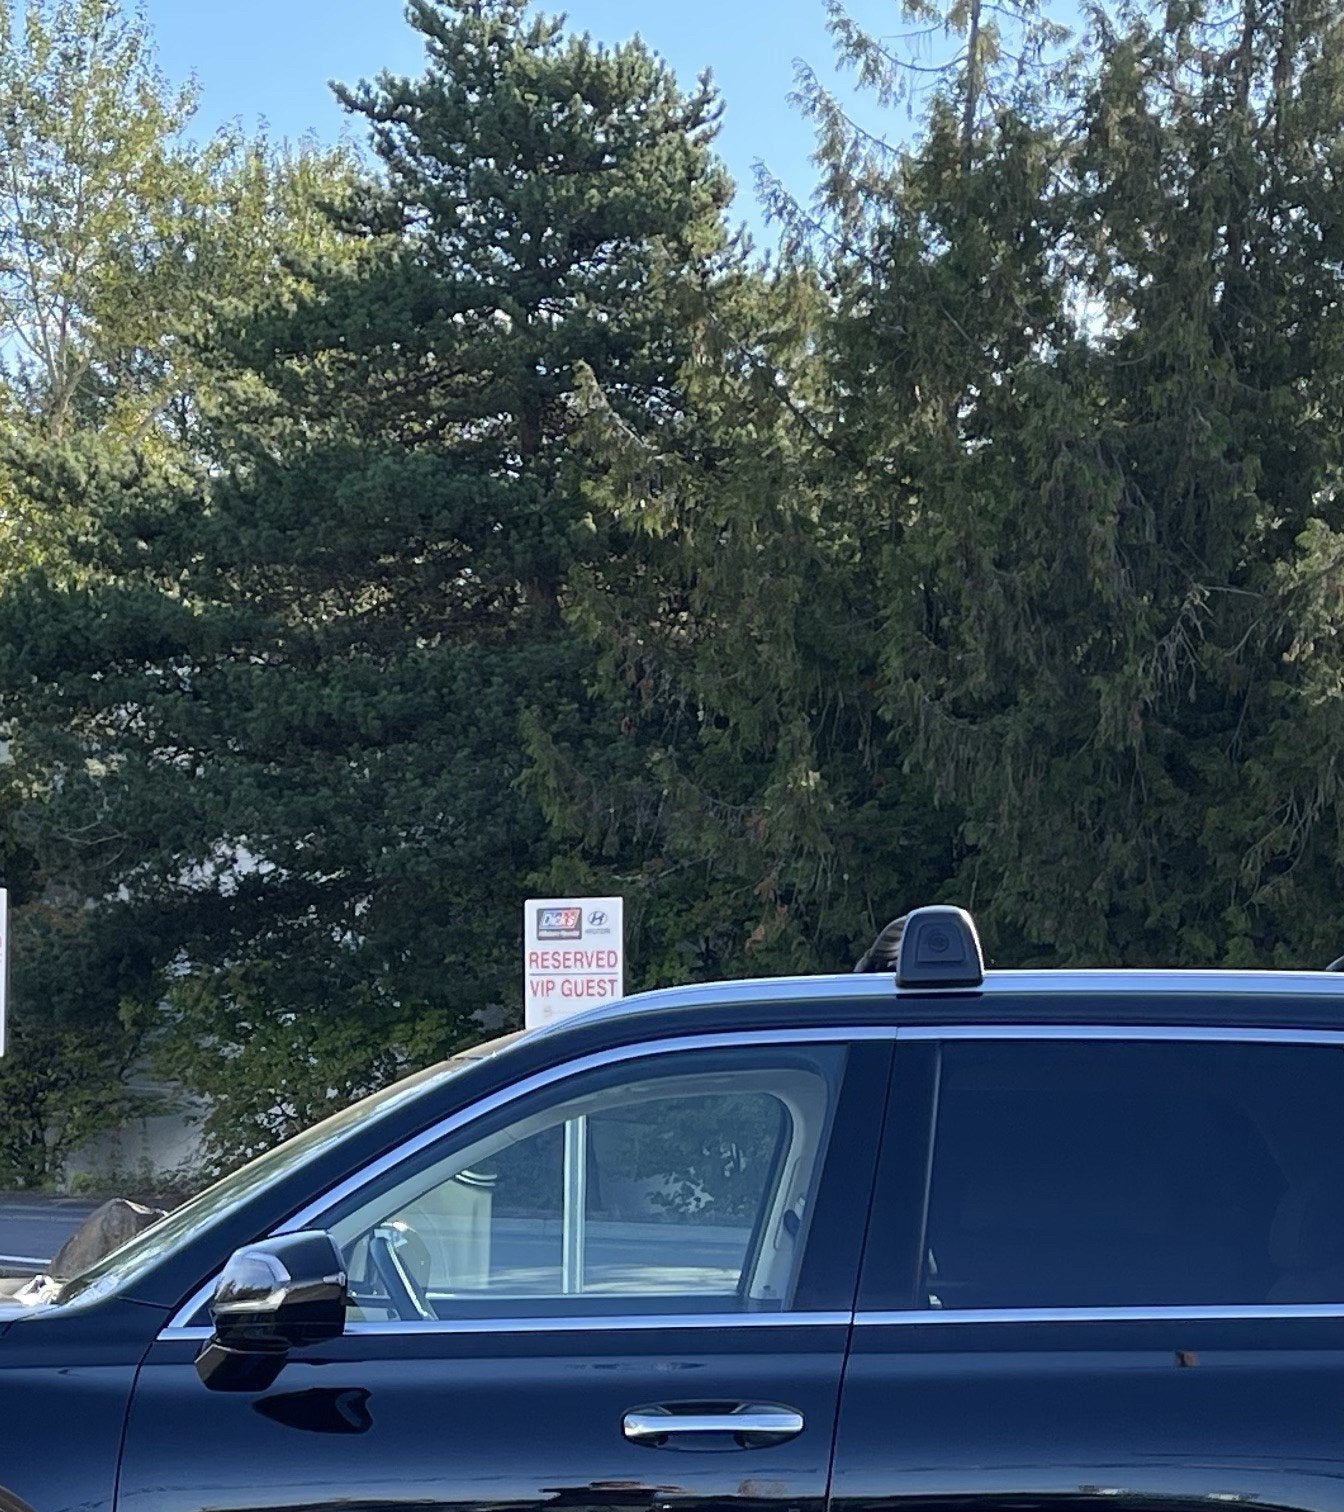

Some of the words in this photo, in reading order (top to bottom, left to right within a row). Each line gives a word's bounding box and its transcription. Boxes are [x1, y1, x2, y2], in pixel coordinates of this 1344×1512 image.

[529, 950, 618, 969] RESERVED
[529, 979, 555, 997] VIP
[561, 978, 618, 997] GUEST
